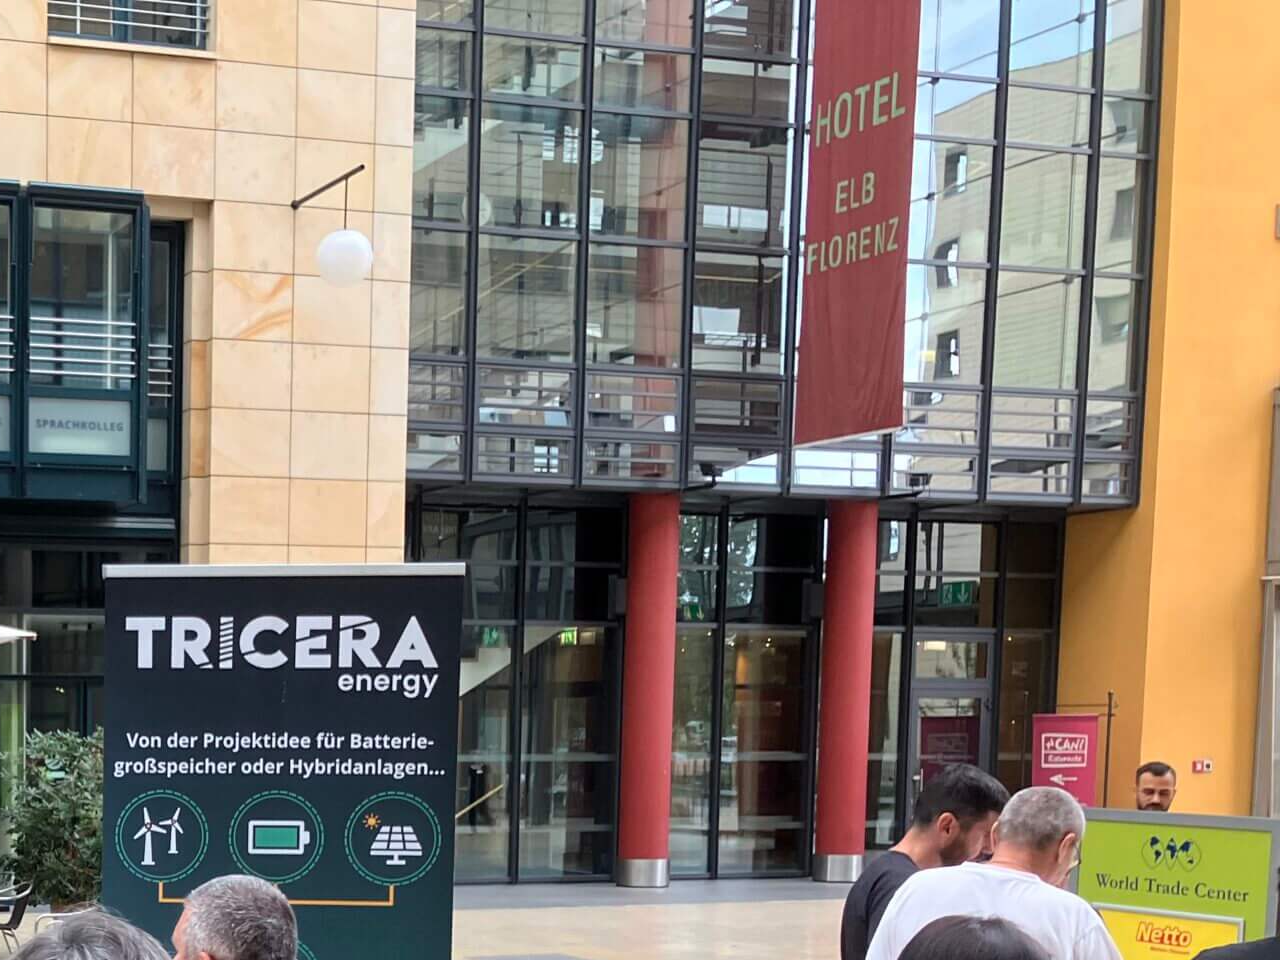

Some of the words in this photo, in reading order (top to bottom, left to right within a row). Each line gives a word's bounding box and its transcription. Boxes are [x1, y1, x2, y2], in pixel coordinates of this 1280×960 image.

[815, 72, 906, 148] HOTEL
[835, 172, 876, 214] ELB
[806, 216, 900, 276] FLORENZ
[35, 418, 124, 432] SPRACHKOLLEG
[124, 615, 439, 670] TRICERA
[337, 672, 439, 699] energy
[126, 732, 162, 749] Von
[167, 732, 198, 749] der
[204, 732, 311, 753] Projektidee
[316, 732, 345, 749] für
[350, 733, 435, 750] Batterie-
[113, 758, 237, 778] großspeicher
[241, 758, 284, 775] oder
[1096, 873, 1139, 892] World
[1144, 877, 1190, 897] Trade
[1194, 882, 1250, 902] Center
[1135, 920, 1193, 947] Netto
